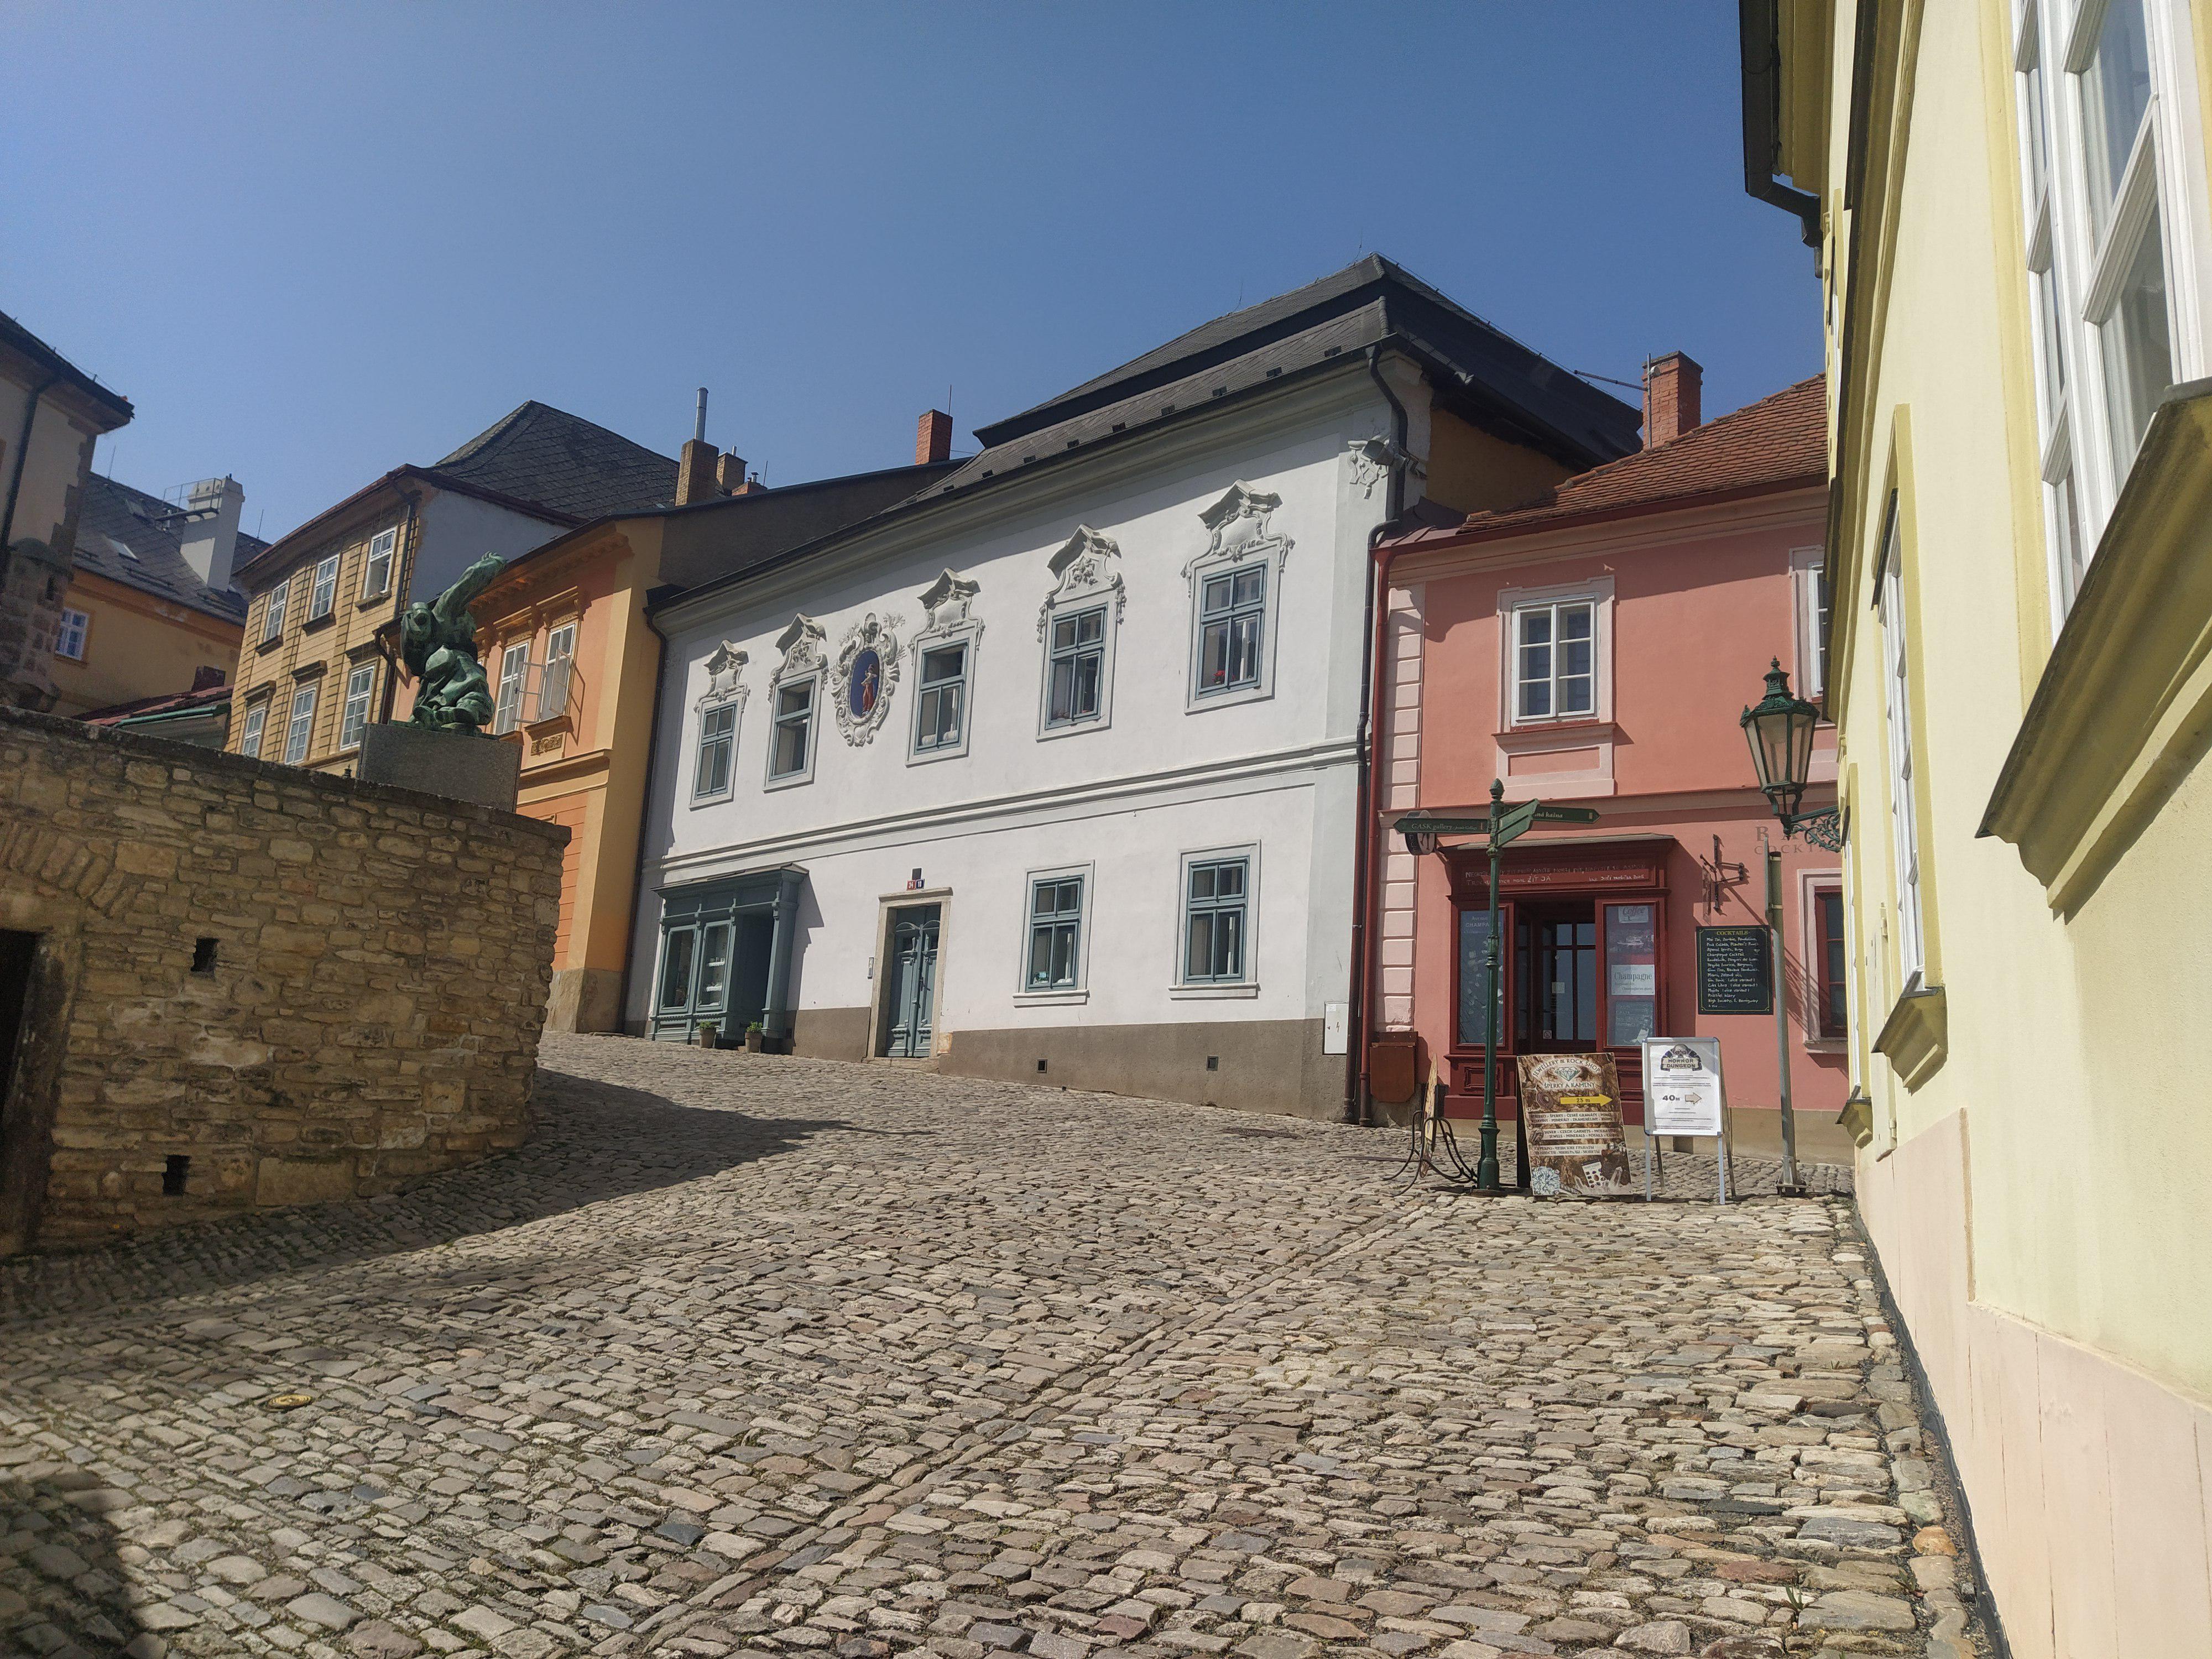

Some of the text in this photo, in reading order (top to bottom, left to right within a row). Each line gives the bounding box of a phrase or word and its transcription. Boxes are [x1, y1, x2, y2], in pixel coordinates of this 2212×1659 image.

[1614, 972, 1652, 982] Champagne
[1532, 1060, 1558, 1078] JEWELLERY
[1585, 1061, 1600, 1072] SHOP
